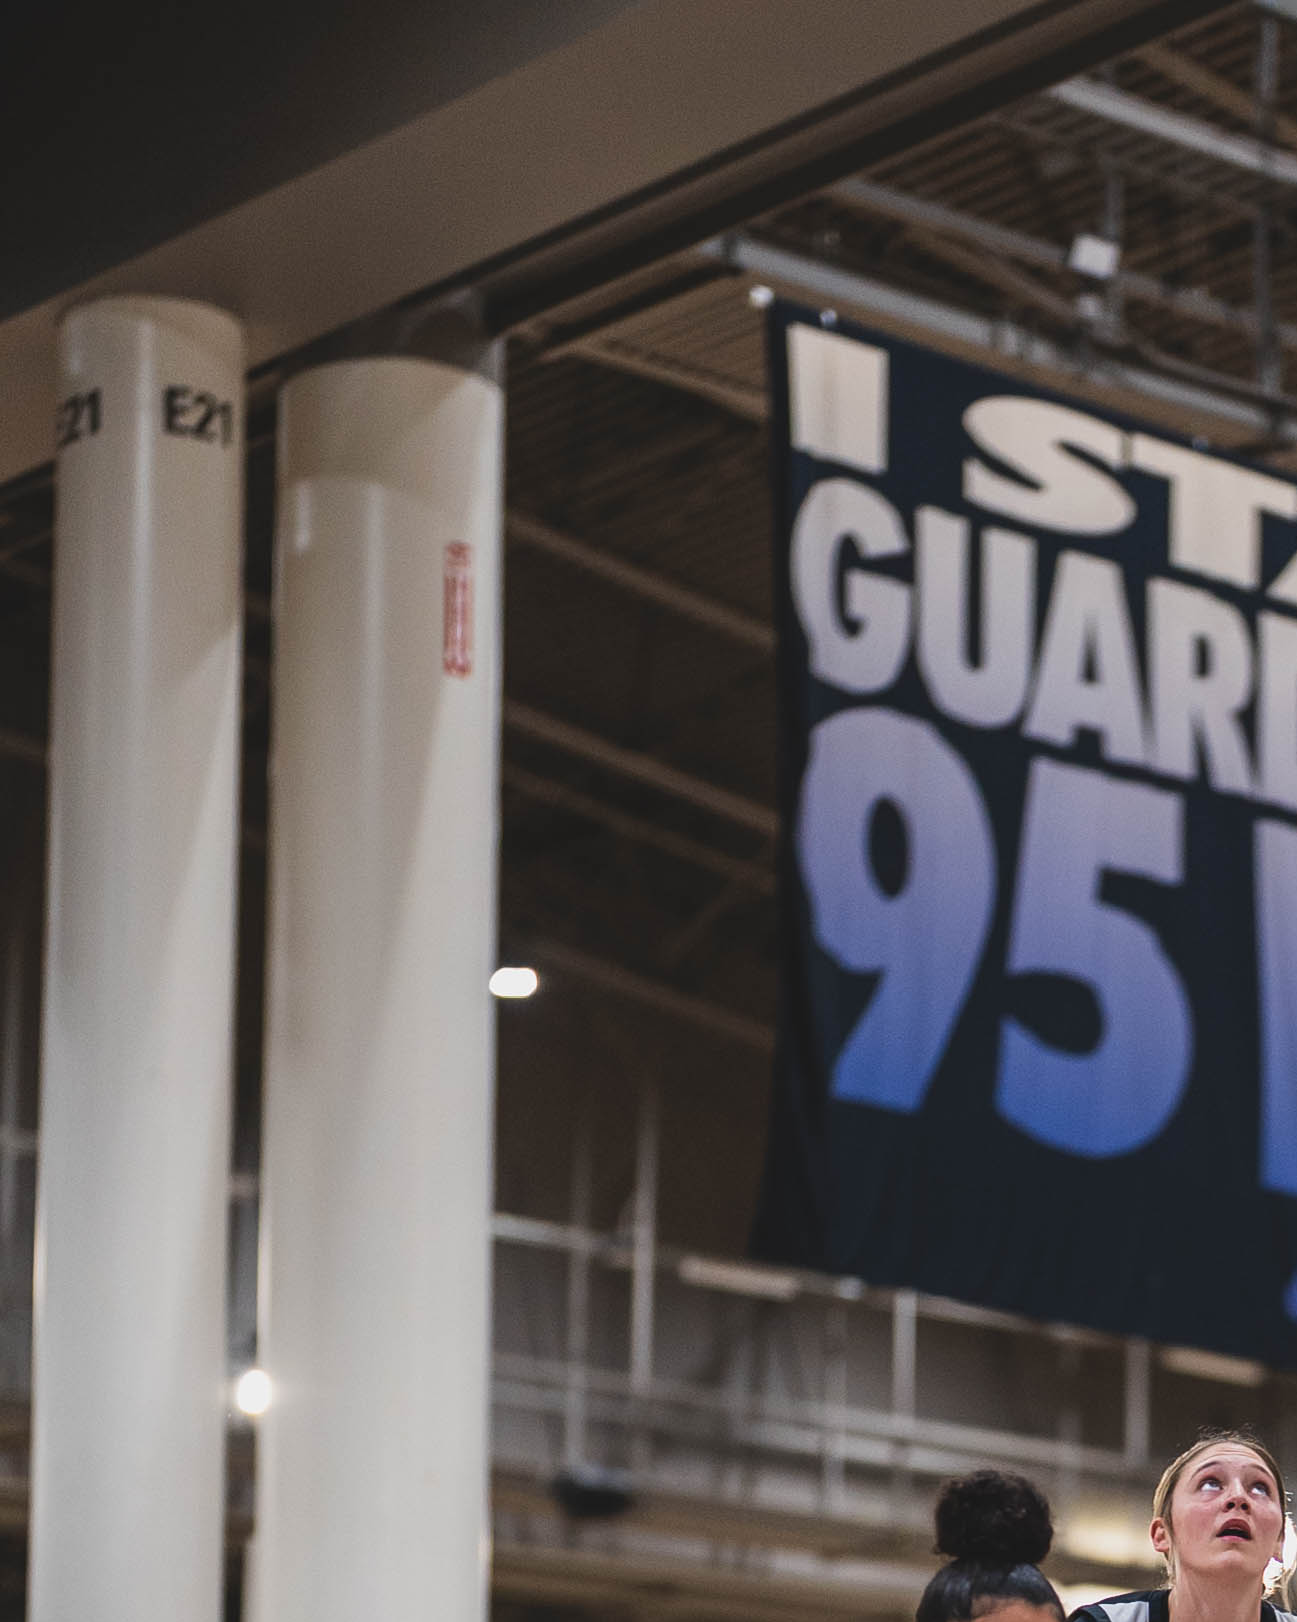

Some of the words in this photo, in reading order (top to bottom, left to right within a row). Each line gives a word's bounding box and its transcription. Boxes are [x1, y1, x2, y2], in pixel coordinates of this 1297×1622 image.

[57, 387, 102, 448] 21
[162, 384, 233, 448] E21
[788, 320, 890, 474] I
[796, 706, 1194, 1159] 95
